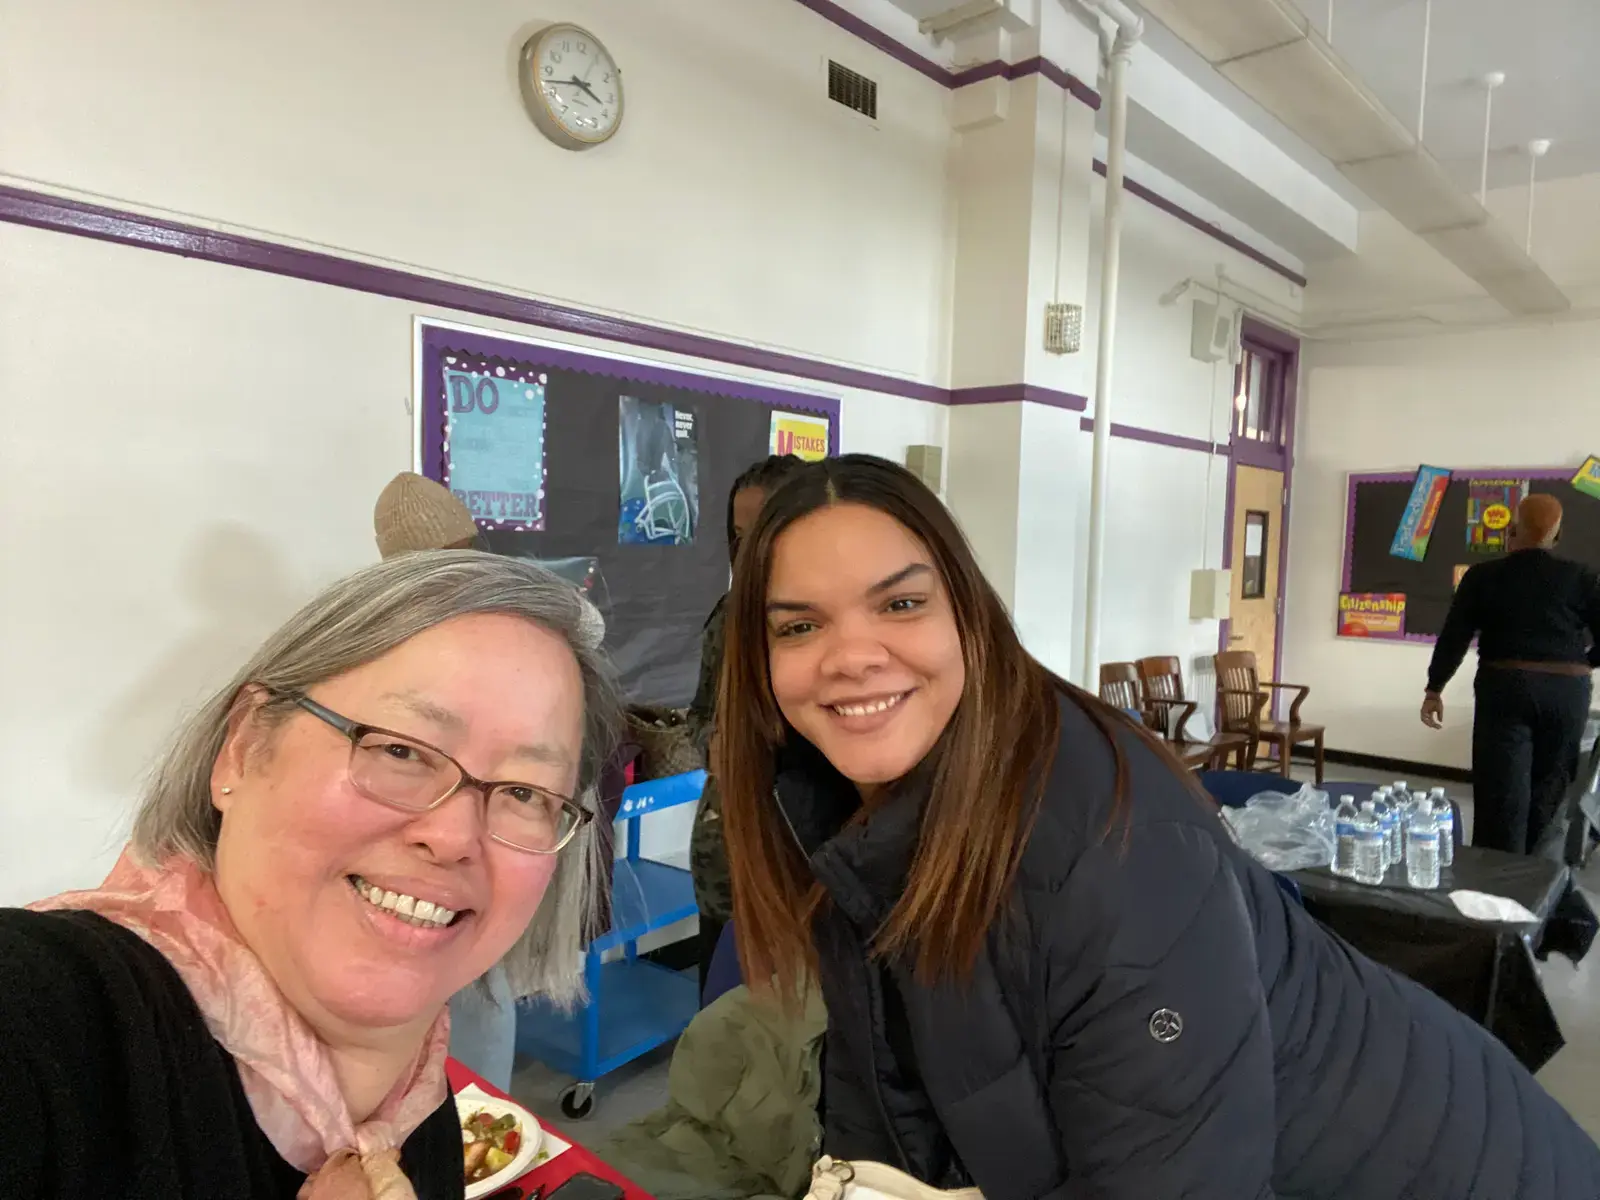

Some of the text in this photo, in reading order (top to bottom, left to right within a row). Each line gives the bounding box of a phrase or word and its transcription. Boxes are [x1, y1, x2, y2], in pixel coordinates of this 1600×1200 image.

[576, 40, 588, 55] 12
[545, 65, 554, 77] 9
[603, 72, 610, 84] 2
[449, 375, 499, 415] DO
[777, 430, 825, 456] MISTAKES
[1340, 594, 1406, 615] Citizenship
